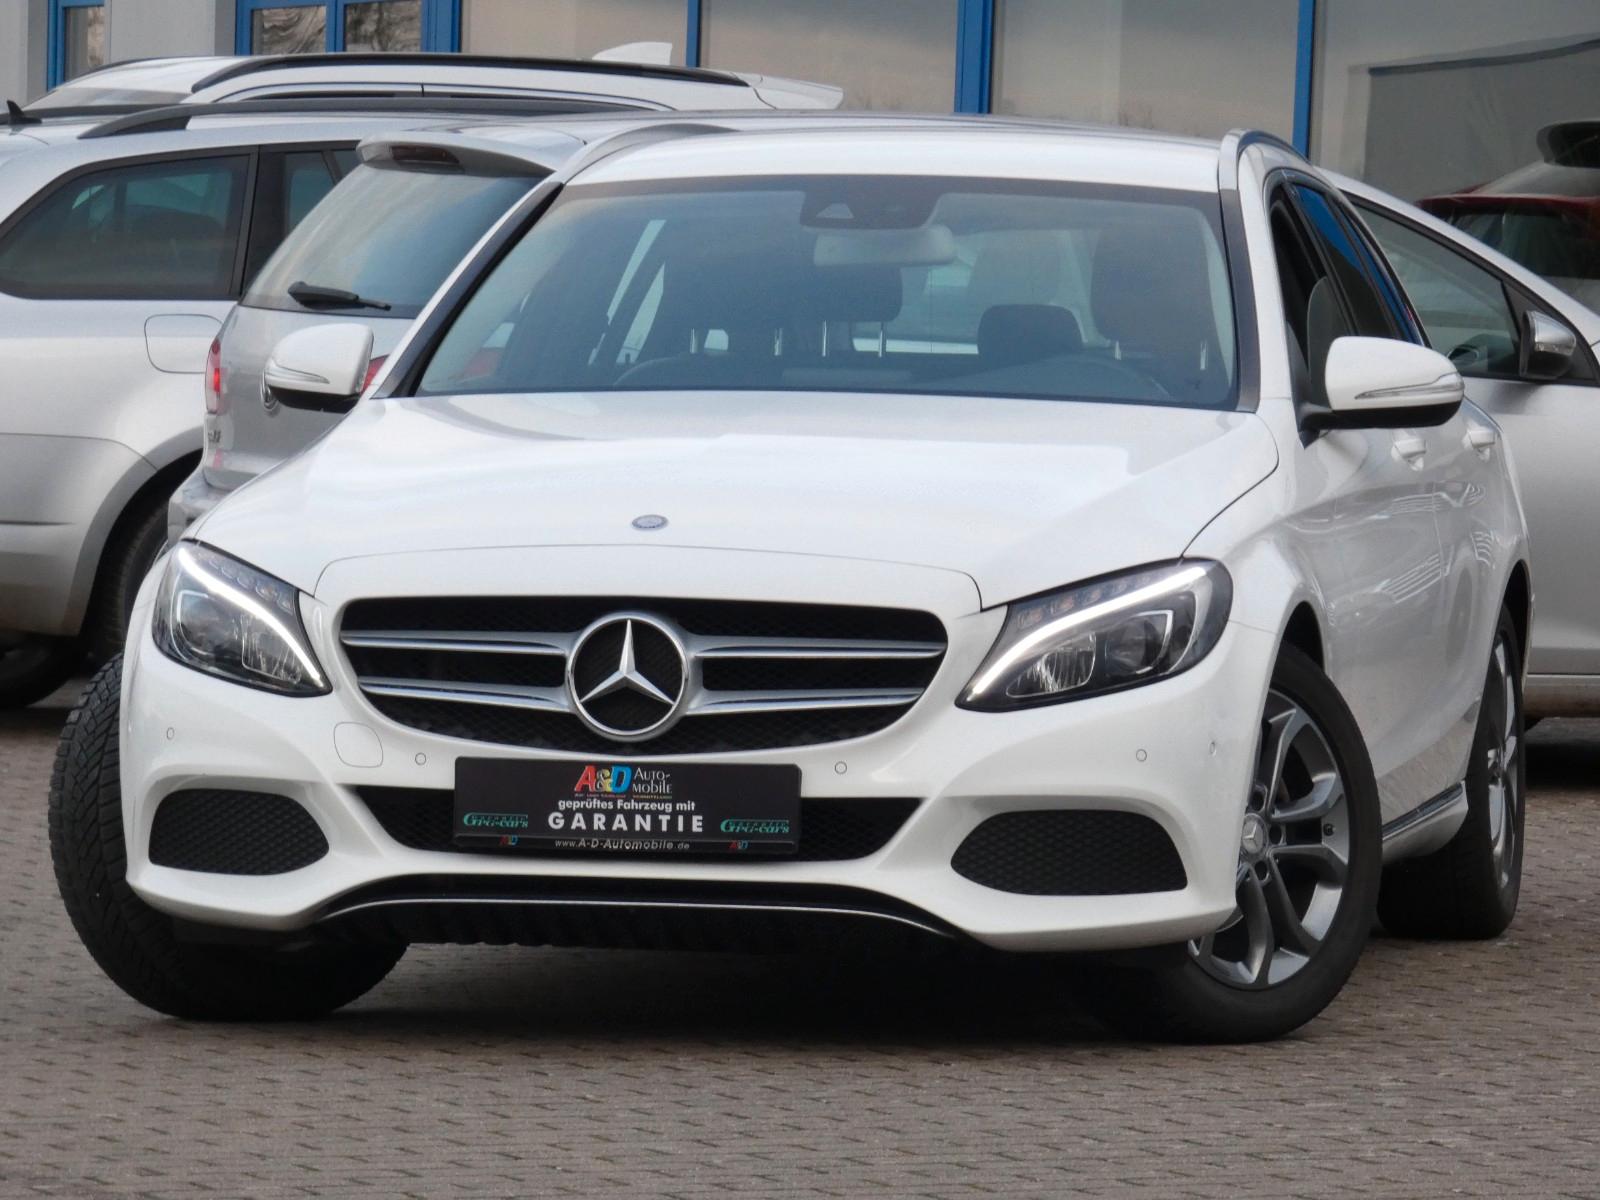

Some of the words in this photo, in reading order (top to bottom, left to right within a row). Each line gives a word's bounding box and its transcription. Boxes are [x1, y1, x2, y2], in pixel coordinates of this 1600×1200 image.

[574, 765, 632, 793] A&D
[558, 799, 614, 811] geprüftes
[617, 800, 672, 813] Fahrzeug
[676, 801, 696, 811] mit
[547, 812, 704, 832] GARANTIE
[554, 838, 691, 850] www.A-D-Automobile.de
